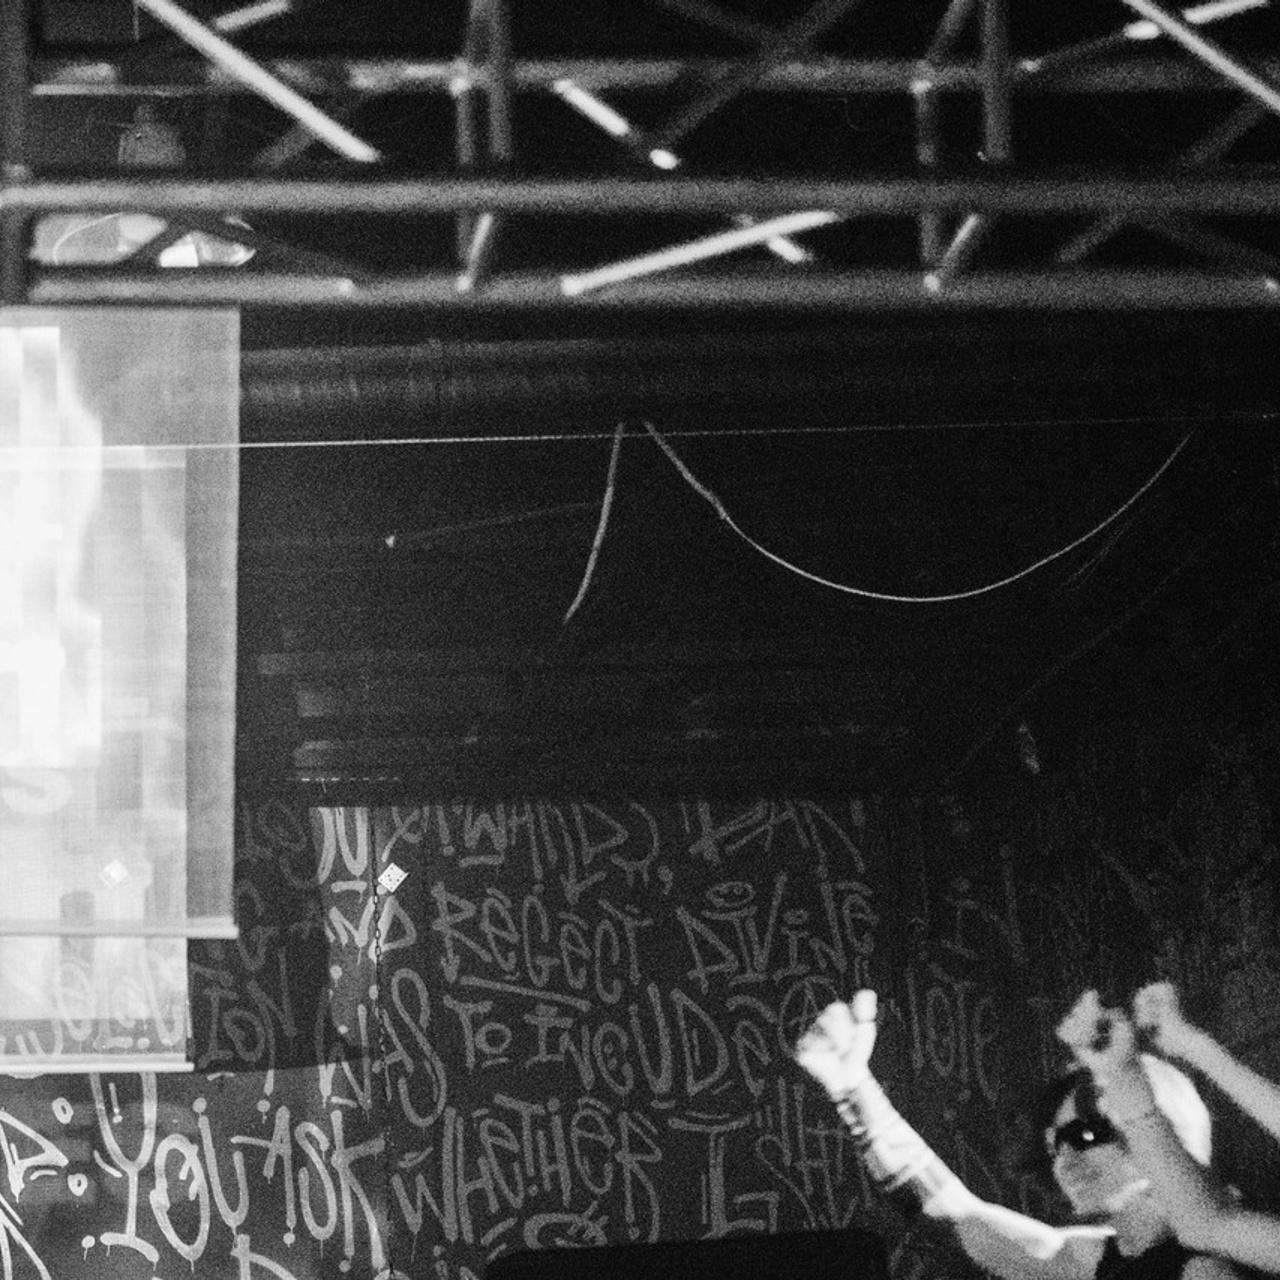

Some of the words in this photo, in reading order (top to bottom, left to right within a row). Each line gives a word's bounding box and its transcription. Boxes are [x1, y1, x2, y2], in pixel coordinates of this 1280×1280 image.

[677, 870, 880, 995] DIVINE
[317, 965, 448, 1127] WAS
[442, 990, 512, 1075] TO
[80, 1072, 250, 1272] YOU
[232, 1100, 390, 1272] ASK
[392, 1090, 665, 1252] WHETHER
